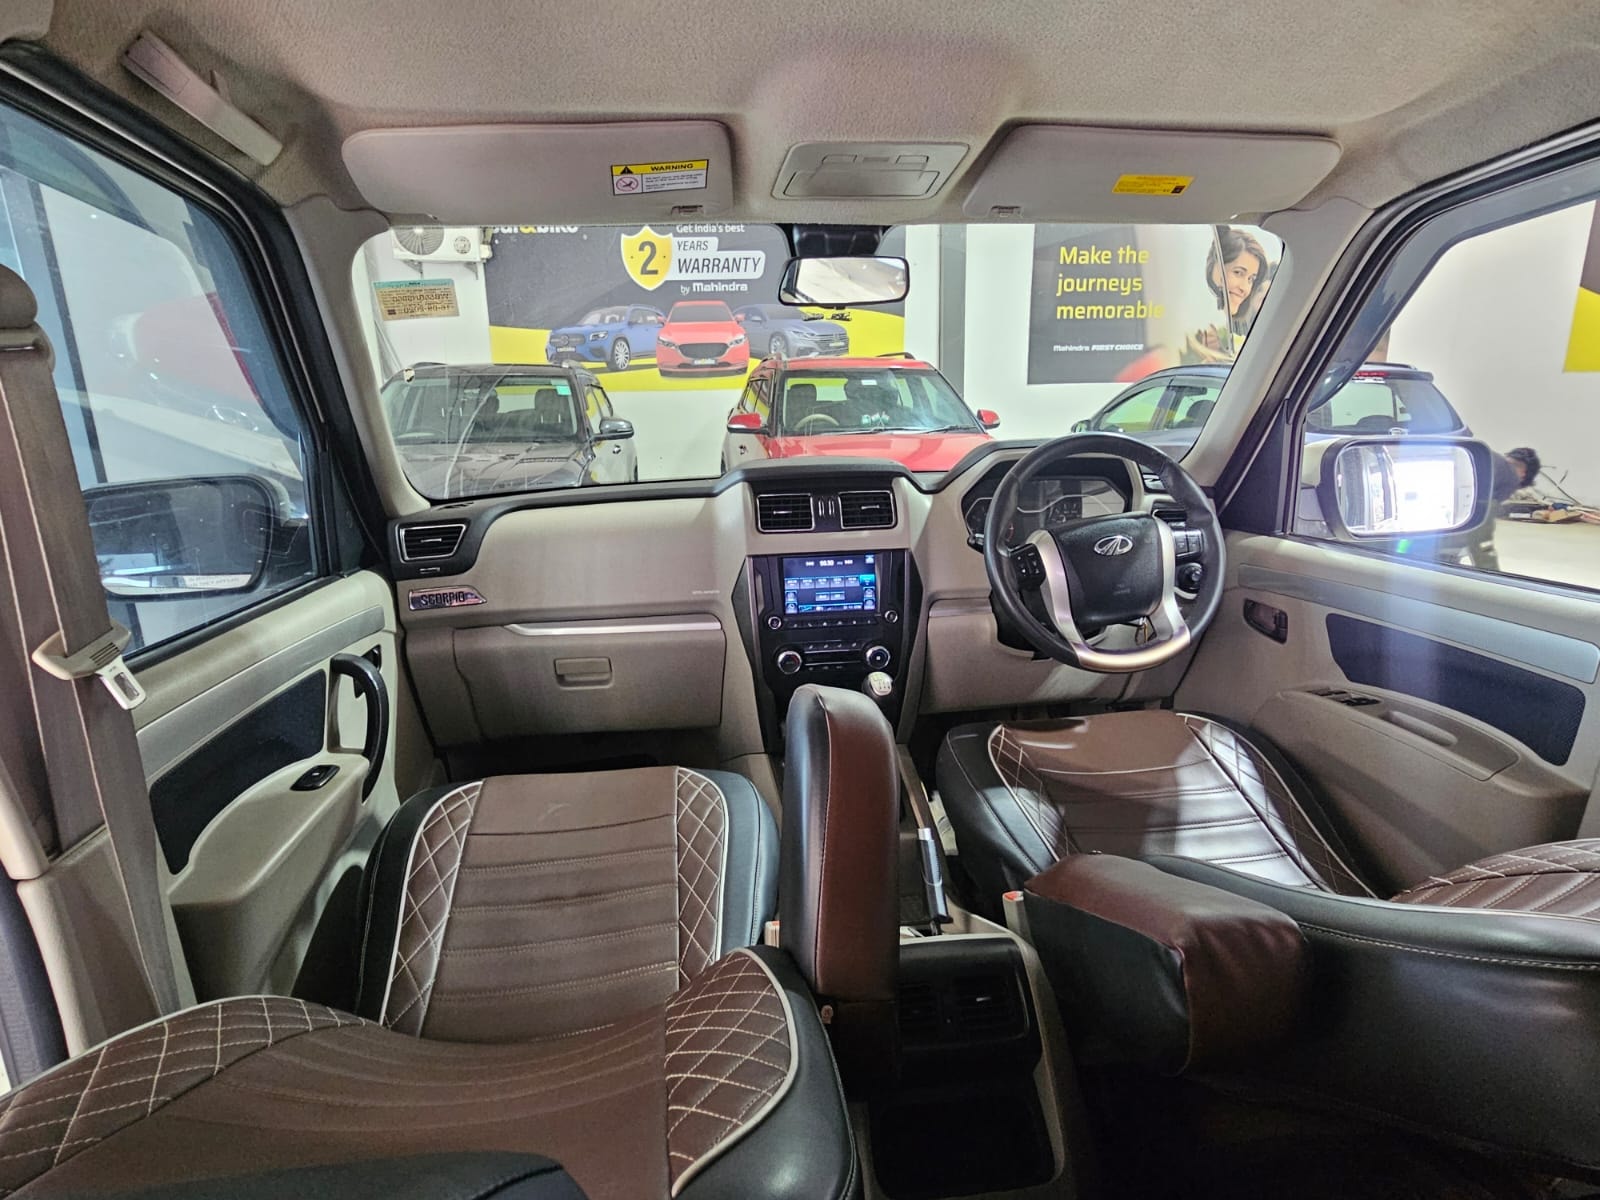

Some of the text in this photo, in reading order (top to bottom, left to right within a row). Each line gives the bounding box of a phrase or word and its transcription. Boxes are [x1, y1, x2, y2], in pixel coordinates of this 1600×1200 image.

[650, 163, 693, 171] WARNING
[676, 224, 745, 233] Get India's best
[677, 240, 709, 251] YEARS
[638, 241, 658, 275] 2
[1059, 246, 1149, 265] Make the
[678, 257, 761, 274] WARRANTY
[681, 282, 748, 296] by Mahindra
[1056, 273, 1143, 297] journeys
[1056, 300, 1165, 319] memorable
[1053, 344, 1090, 352] Mahindra
[421, 591, 465, 605] SCORPIO
